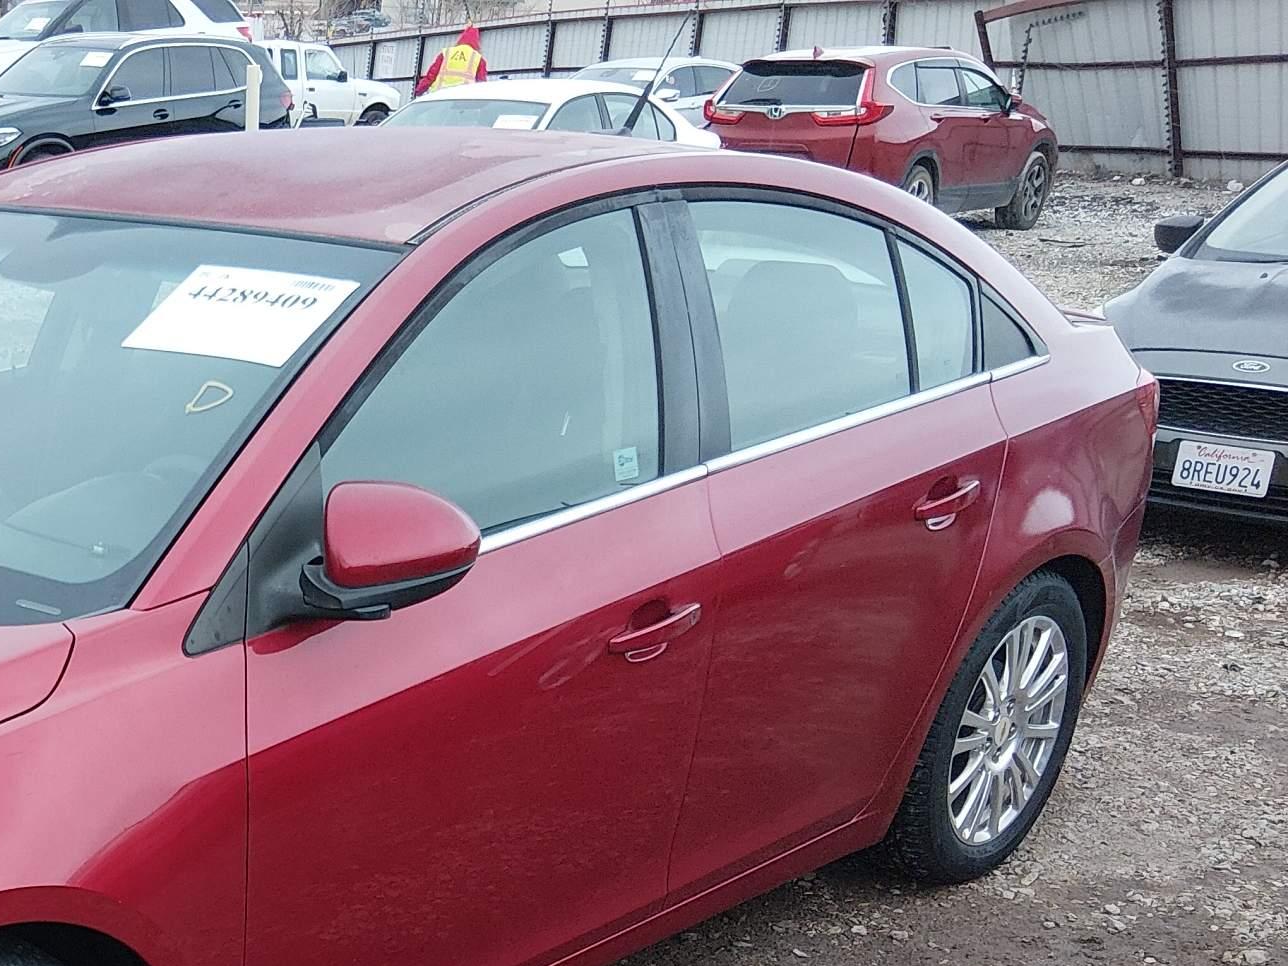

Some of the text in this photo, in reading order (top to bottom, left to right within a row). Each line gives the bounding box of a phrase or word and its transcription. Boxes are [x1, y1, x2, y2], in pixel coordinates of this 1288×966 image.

[188, 285, 319, 309] 44289409
[1197, 446, 1251, 462] California
[1179, 459, 1262, 490] 8REU924
